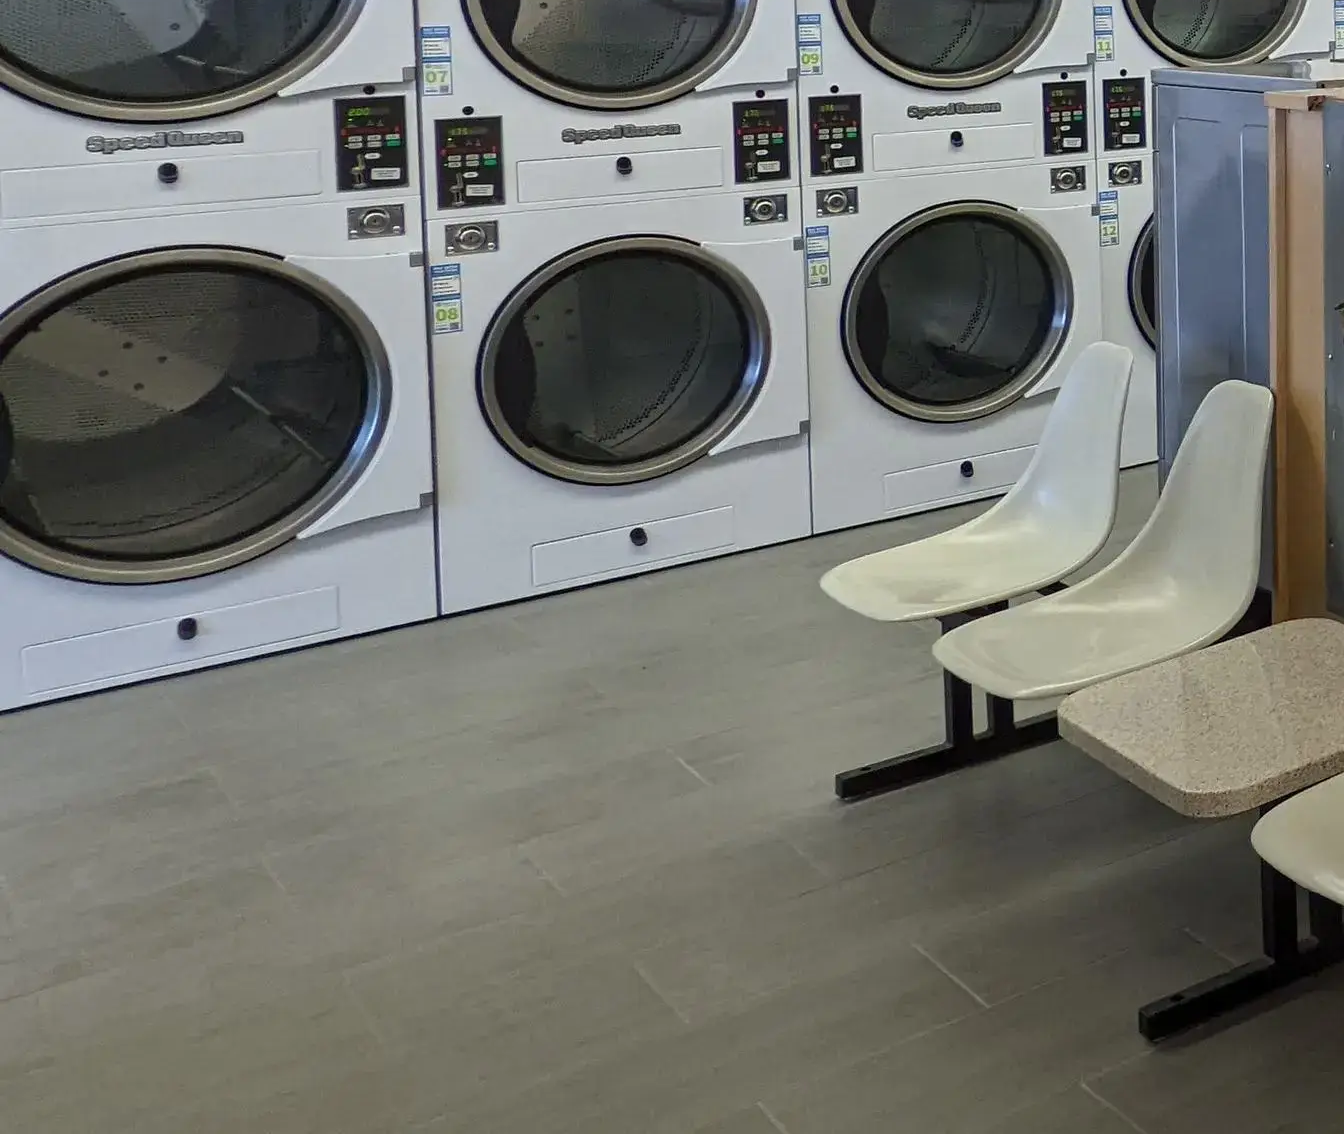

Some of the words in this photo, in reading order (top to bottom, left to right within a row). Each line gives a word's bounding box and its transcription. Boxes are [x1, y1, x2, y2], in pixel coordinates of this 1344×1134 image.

[1098, 41, 1111, 51] 11
[801, 53, 819, 65] 09
[425, 70, 449, 84] 07
[907, 102, 955, 120] Speed
[955, 102, 1001, 115] Queen
[561, 125, 622, 145] Speed
[622, 124, 681, 138] Queen
[86, 132, 167, 154] Speed
[167, 130, 244, 146] Queen
[1102, 225, 1117, 236] 12
[811, 264, 828, 276] 10
[436, 307, 458, 322] 08
